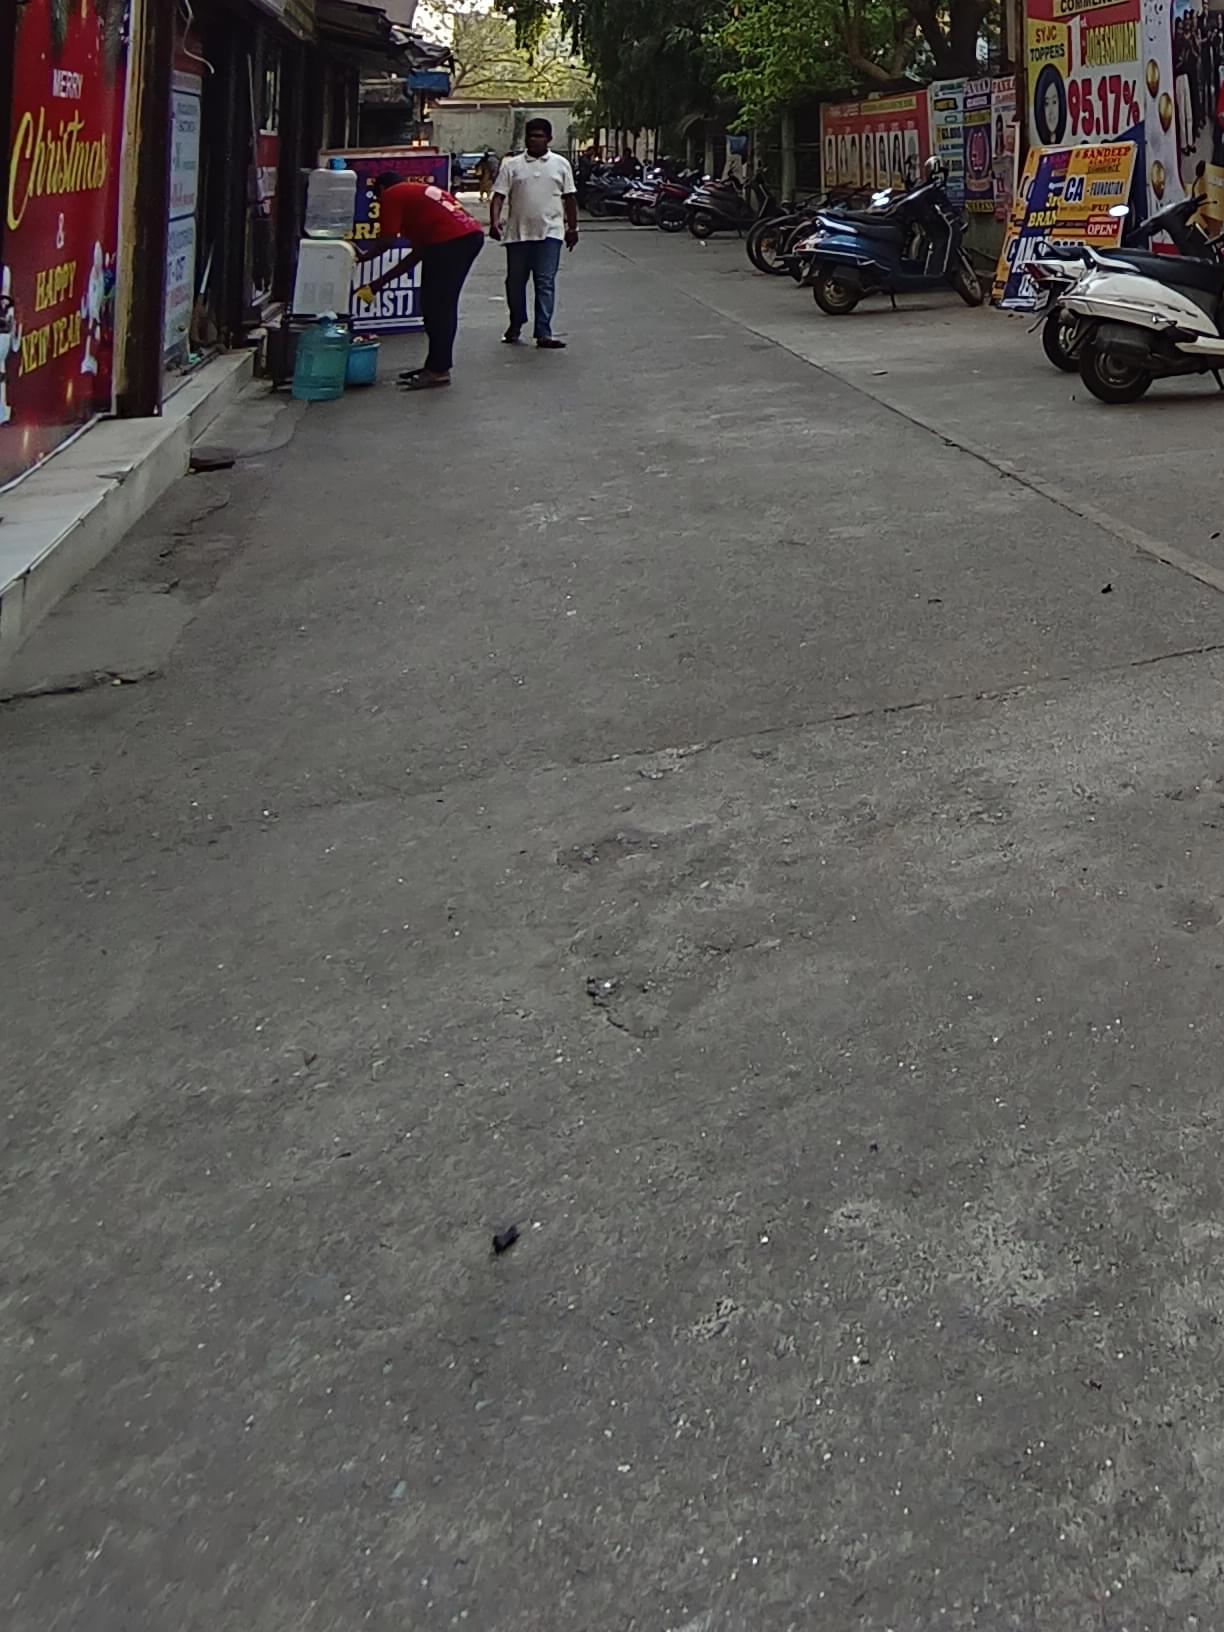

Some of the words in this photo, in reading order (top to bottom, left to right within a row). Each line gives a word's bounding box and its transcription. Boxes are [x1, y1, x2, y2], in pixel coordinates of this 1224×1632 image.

[1036, 25, 1057, 43] SYJC
[1030, 43, 1065, 62] TOPPERS
[53, 68, 84, 99] MERRY
[1067, 74, 1140, 136] 95.17%
[1082, 146, 1131, 160] SANDEEP
[7, 107, 108, 231] Christmas
[1064, 177, 1085, 202] CA
[35, 261, 77, 312] HAPPY
[18, 325, 50, 377] NEW
[52, 311, 81, 359] YEAR
